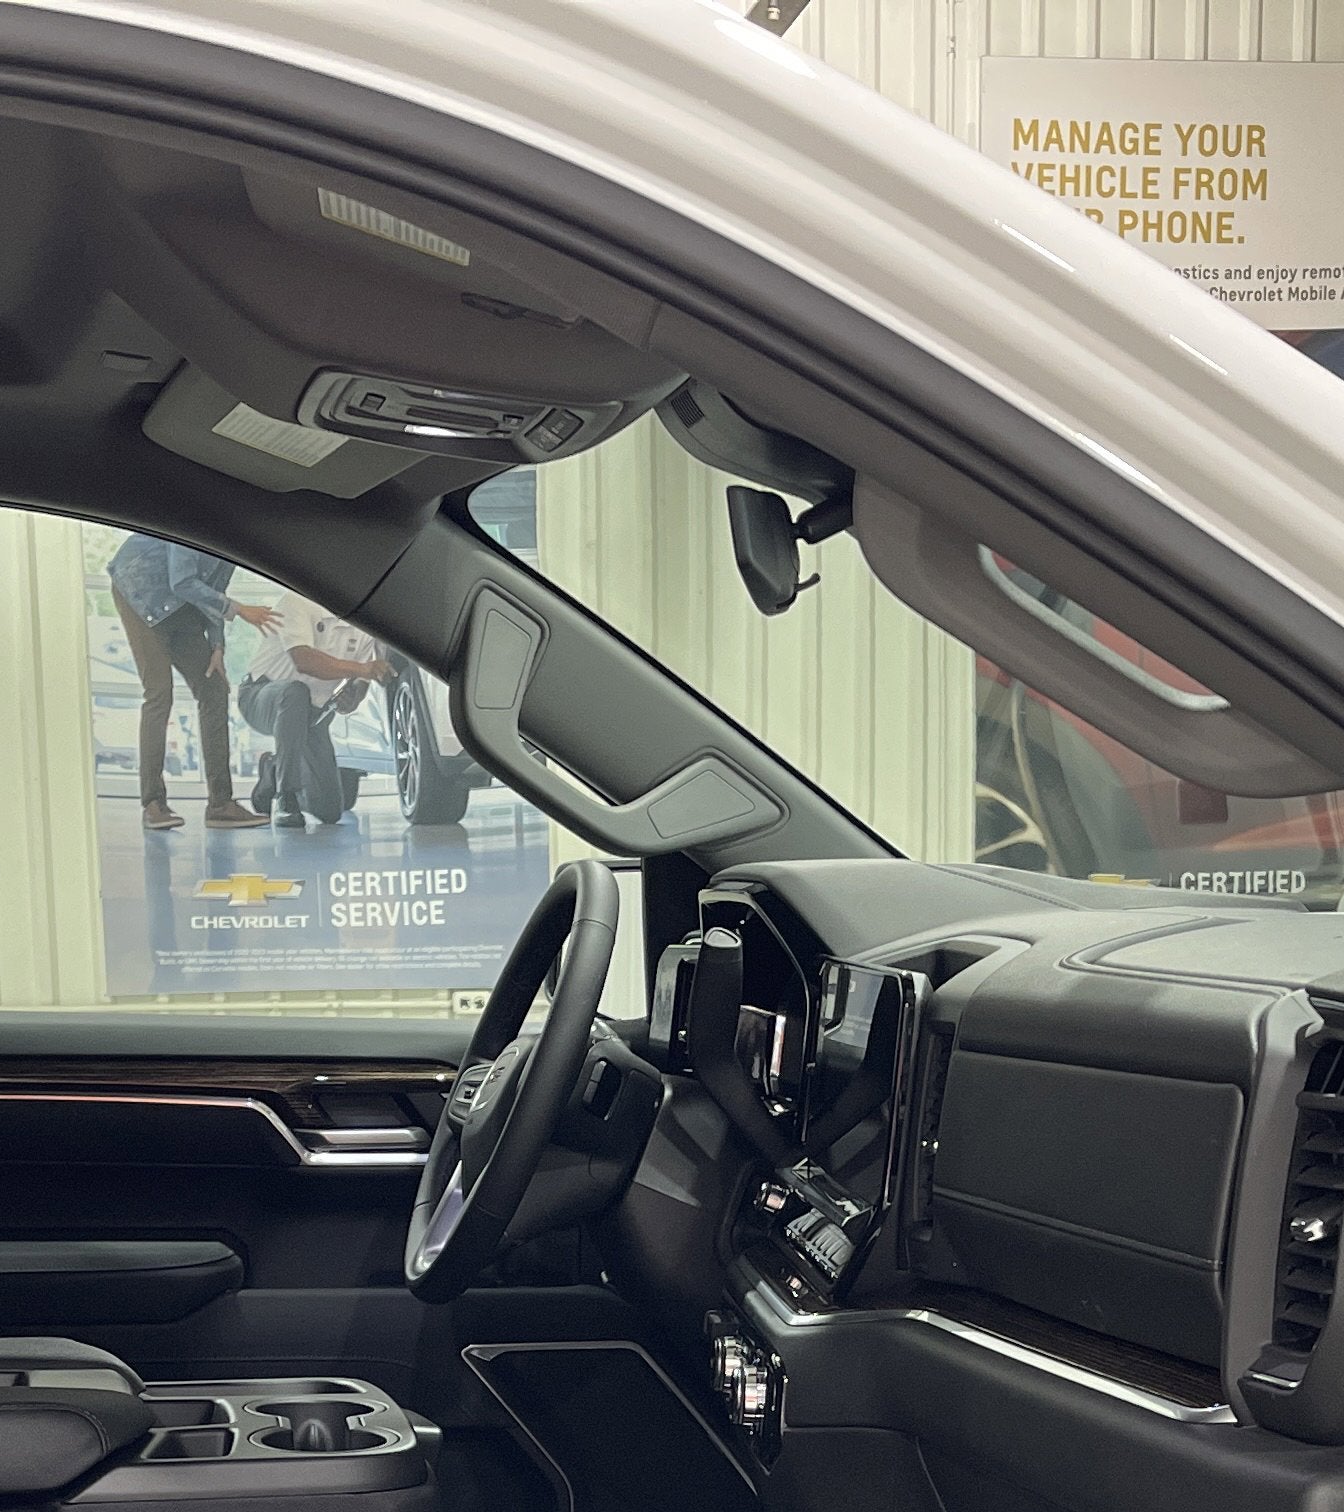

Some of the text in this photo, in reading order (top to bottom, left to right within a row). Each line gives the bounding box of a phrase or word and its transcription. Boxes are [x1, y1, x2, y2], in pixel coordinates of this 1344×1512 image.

[1013, 117, 1267, 157] MANAGE YOUR
[1173, 168, 1268, 201] FROM
[1118, 209, 1245, 244] PHONE.
[1224, 264, 1252, 280] and
[1256, 264, 1298, 284] enjoy
[1288, 285, 1337, 301] Mobile
[329, 868, 467, 898] CERTIFIED
[1179, 870, 1306, 894] CERTIFIED
[190, 914, 310, 930] CHEVROLET
[330, 899, 446, 928] SERVICE
